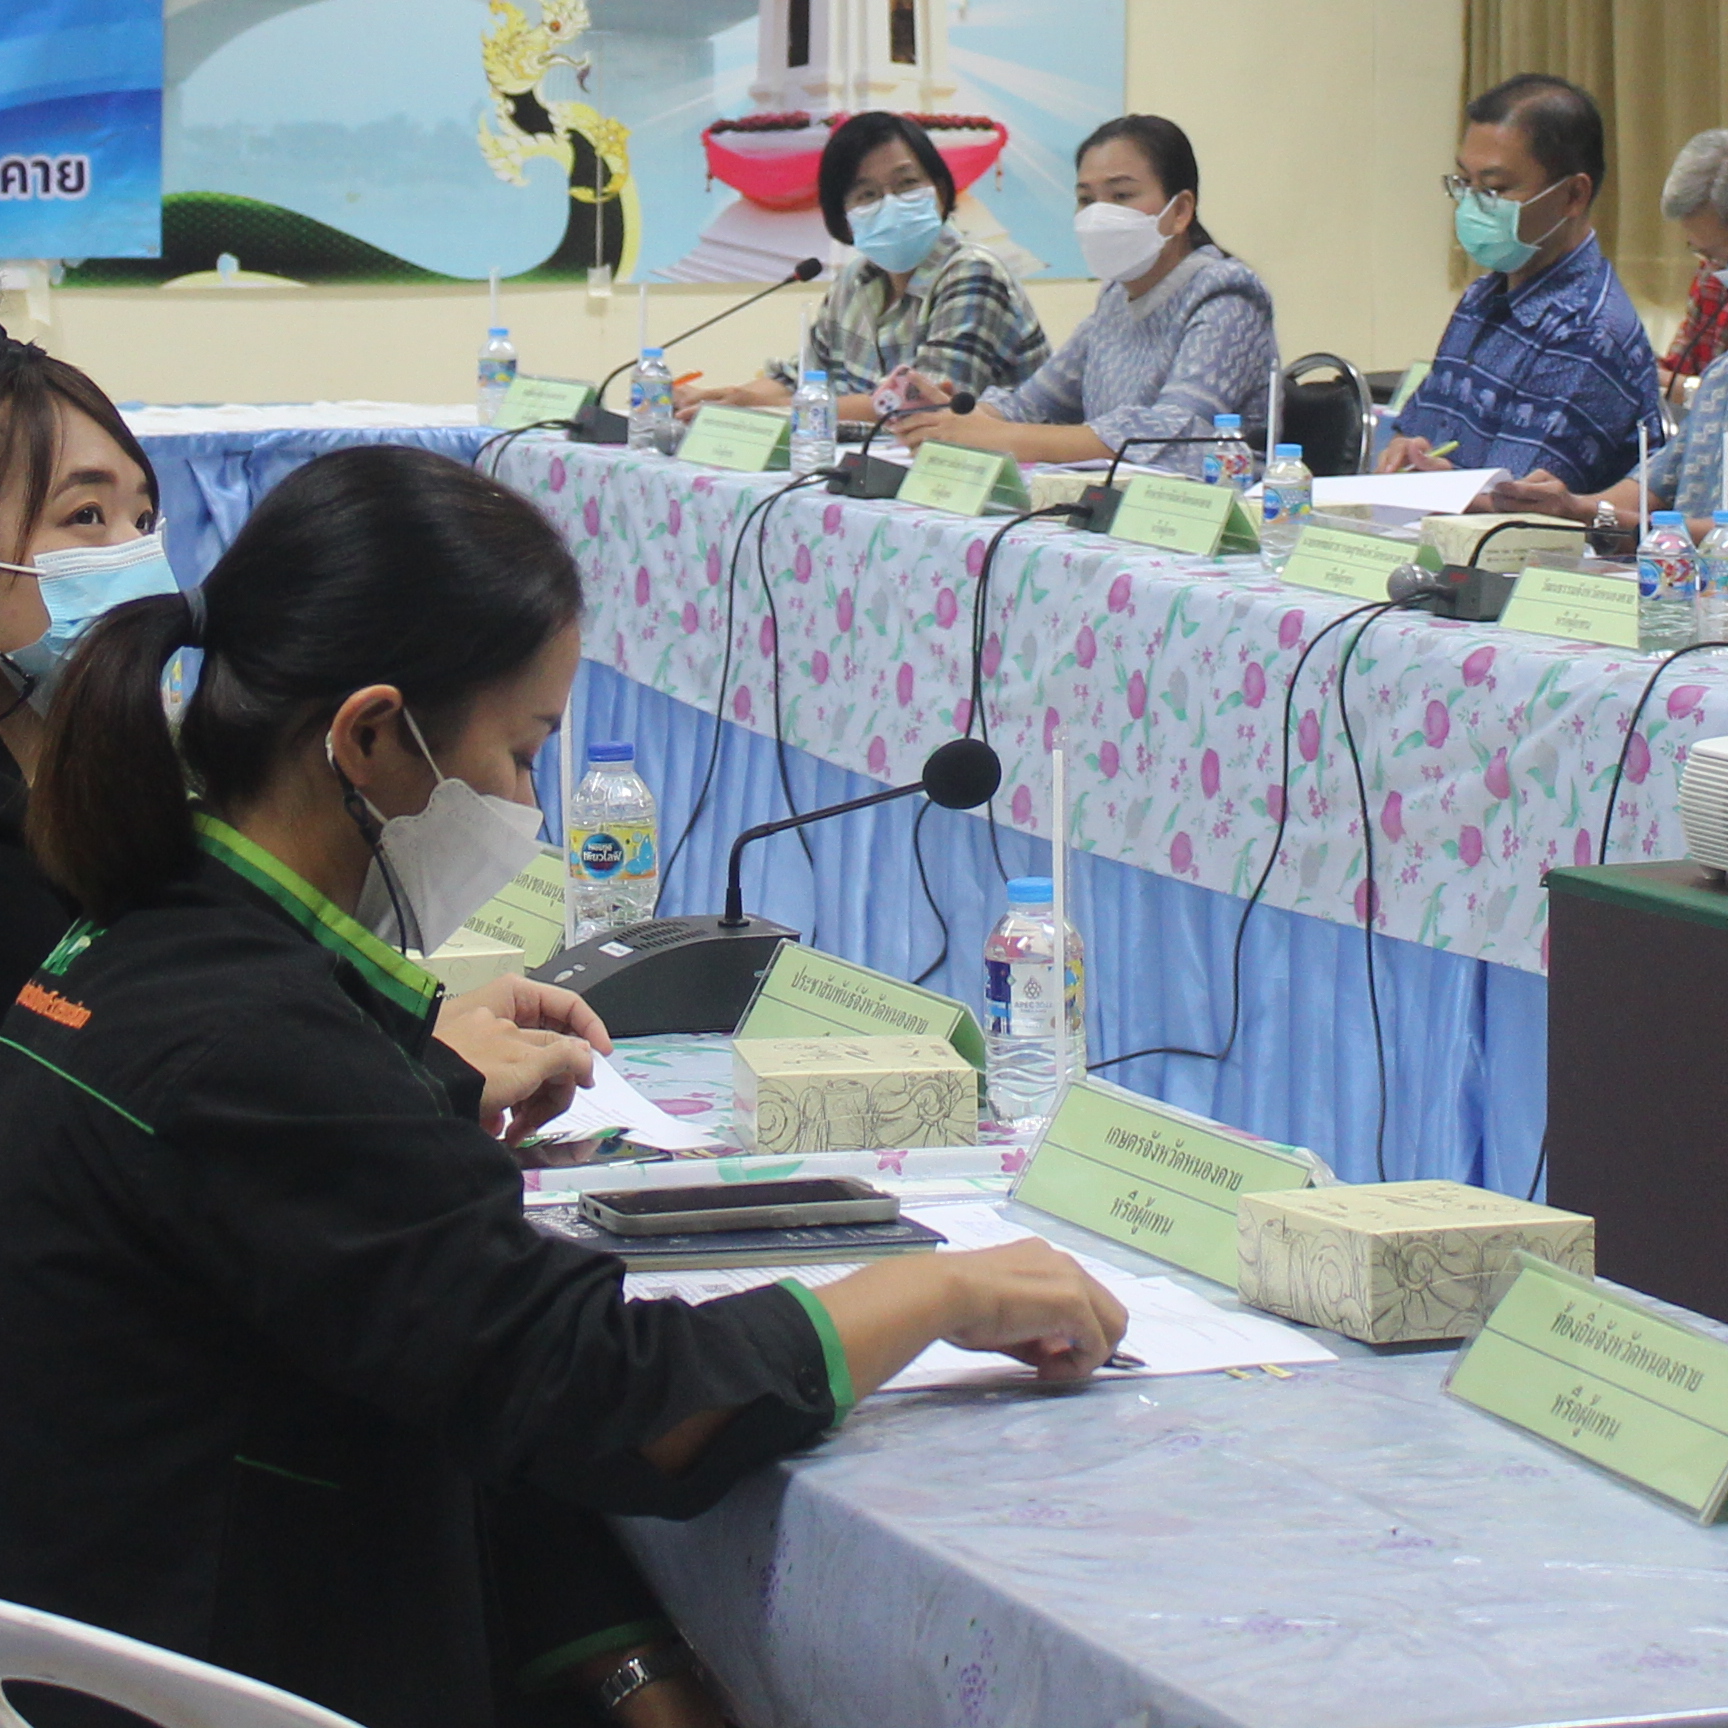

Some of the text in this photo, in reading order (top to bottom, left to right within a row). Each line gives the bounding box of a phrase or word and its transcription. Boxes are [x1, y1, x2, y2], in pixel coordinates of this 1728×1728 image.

[790, 964, 930, 1035] ประชาสัมพันธ์จังหวัดหนองคาย
[1104, 1125, 1244, 1192] เกษตรจังหวัดหนองคาย
[1109, 1189, 1175, 1237] หรือผู้แทน
[1550, 1301, 1705, 1393] ท้องถิ่นจังหวัดหนองคาย
[1550, 1385, 1622, 1441] หรือผู้แทน
